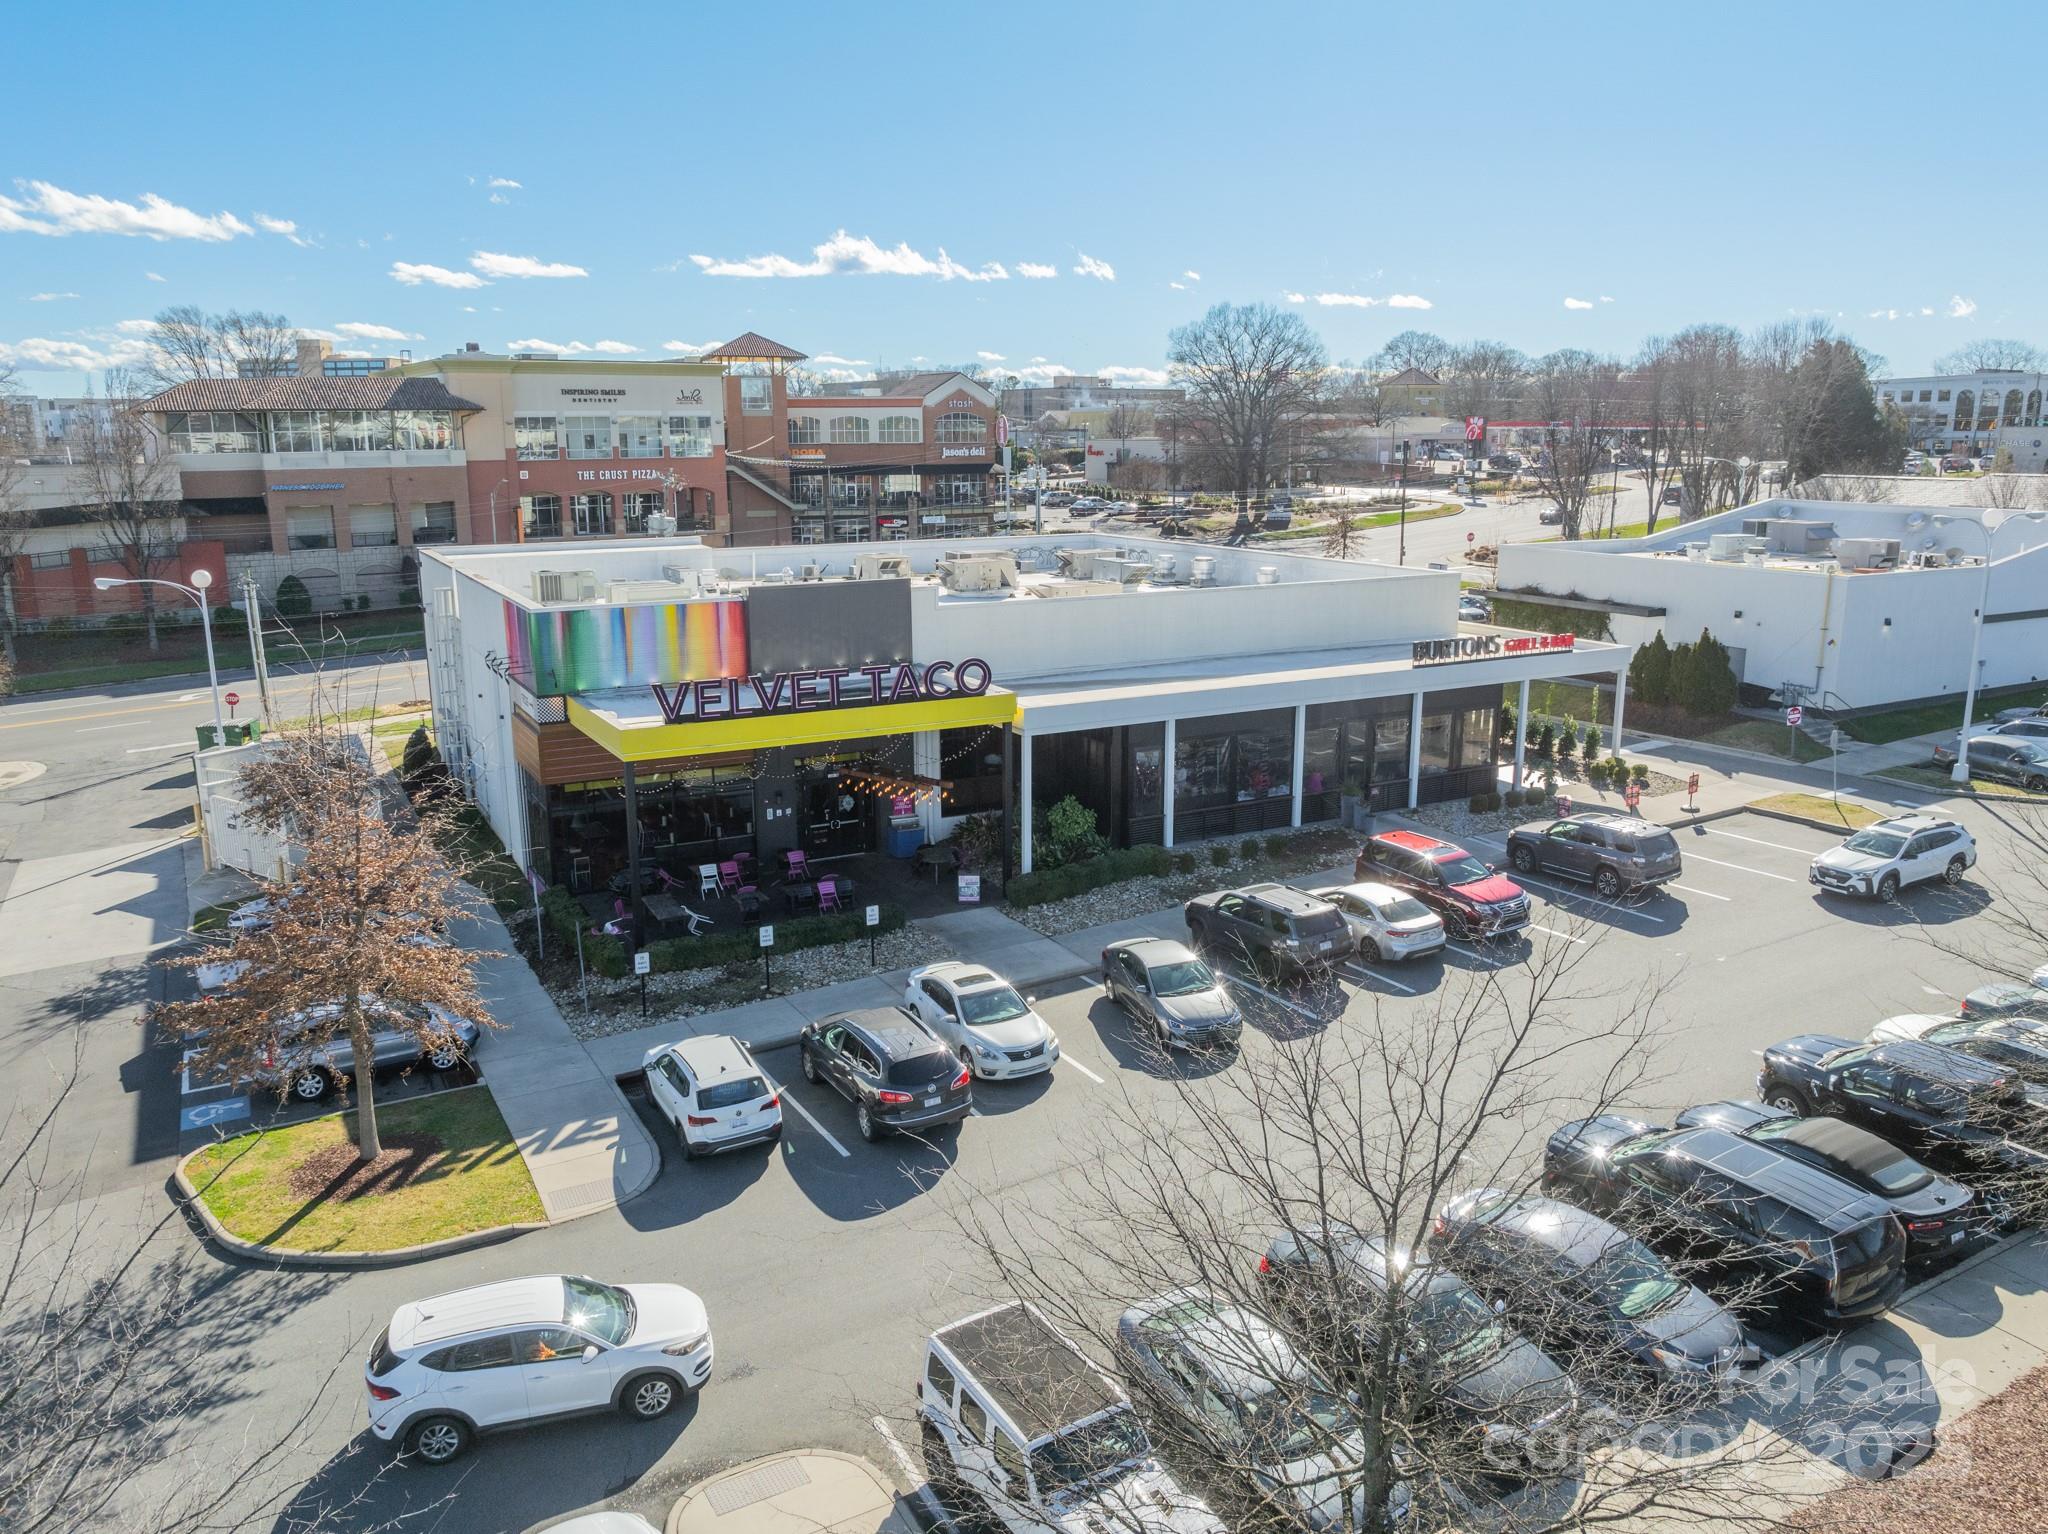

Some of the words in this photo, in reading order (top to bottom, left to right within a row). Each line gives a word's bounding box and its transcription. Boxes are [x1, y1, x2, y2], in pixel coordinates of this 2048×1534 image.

[560, 388, 599, 396] INSPIRING
[600, 388, 626, 396] SMILES
[948, 397, 974, 408] stash
[942, 447, 969, 459] Jason's
[970, 446, 986, 457] deli
[577, 470, 595, 480] THE
[599, 470, 628, 480] CRUST
[632, 469, 658, 480] PIZZA
[1412, 634, 1501, 662] BURTONS
[651, 668, 849, 721] VELVET
[860, 656, 993, 703] TACO
